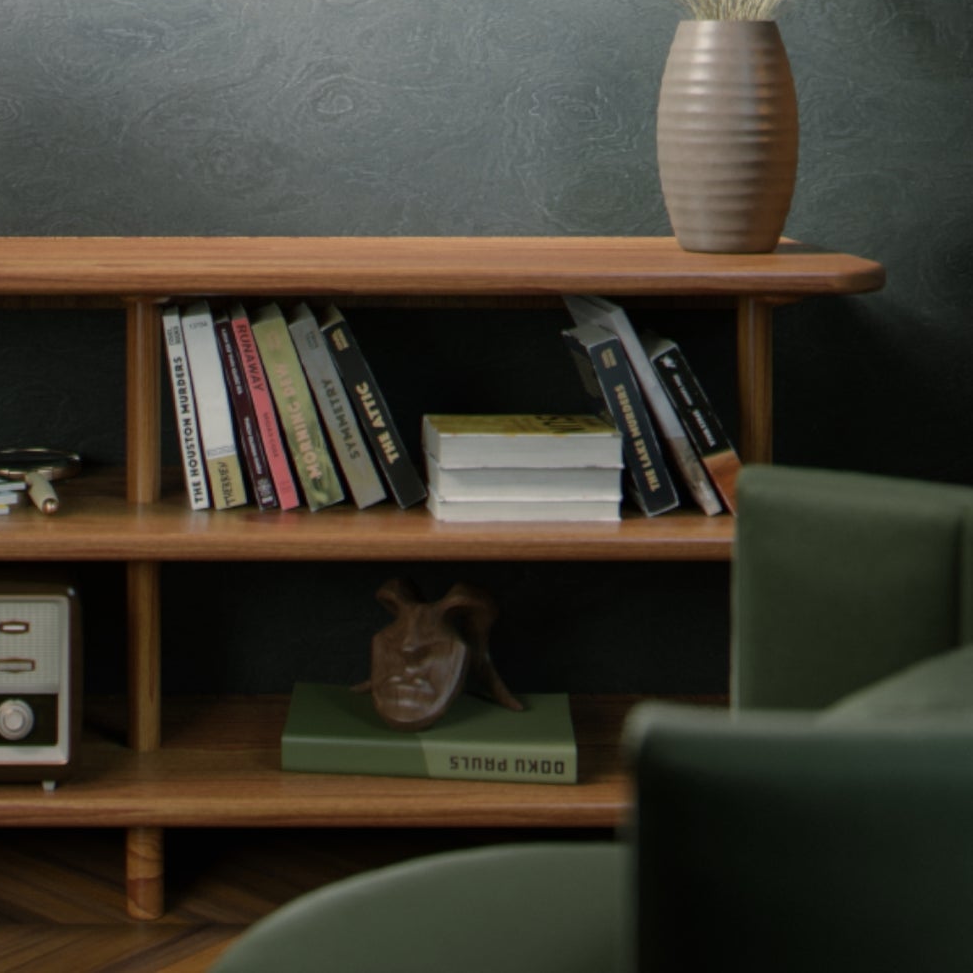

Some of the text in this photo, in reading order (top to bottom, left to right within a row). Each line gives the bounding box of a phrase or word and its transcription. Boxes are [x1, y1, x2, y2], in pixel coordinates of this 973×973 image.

[236, 324, 264, 391] RUNAWAY
[173, 356, 203, 503] THE HOUSTON MURDERS
[275, 363, 322, 479] MORNING DEW
[322, 379, 360, 459] SYMMETRY
[356, 382, 400, 463] THE ATTIC
[615, 385, 660, 492] THE LAKE MURDERS
